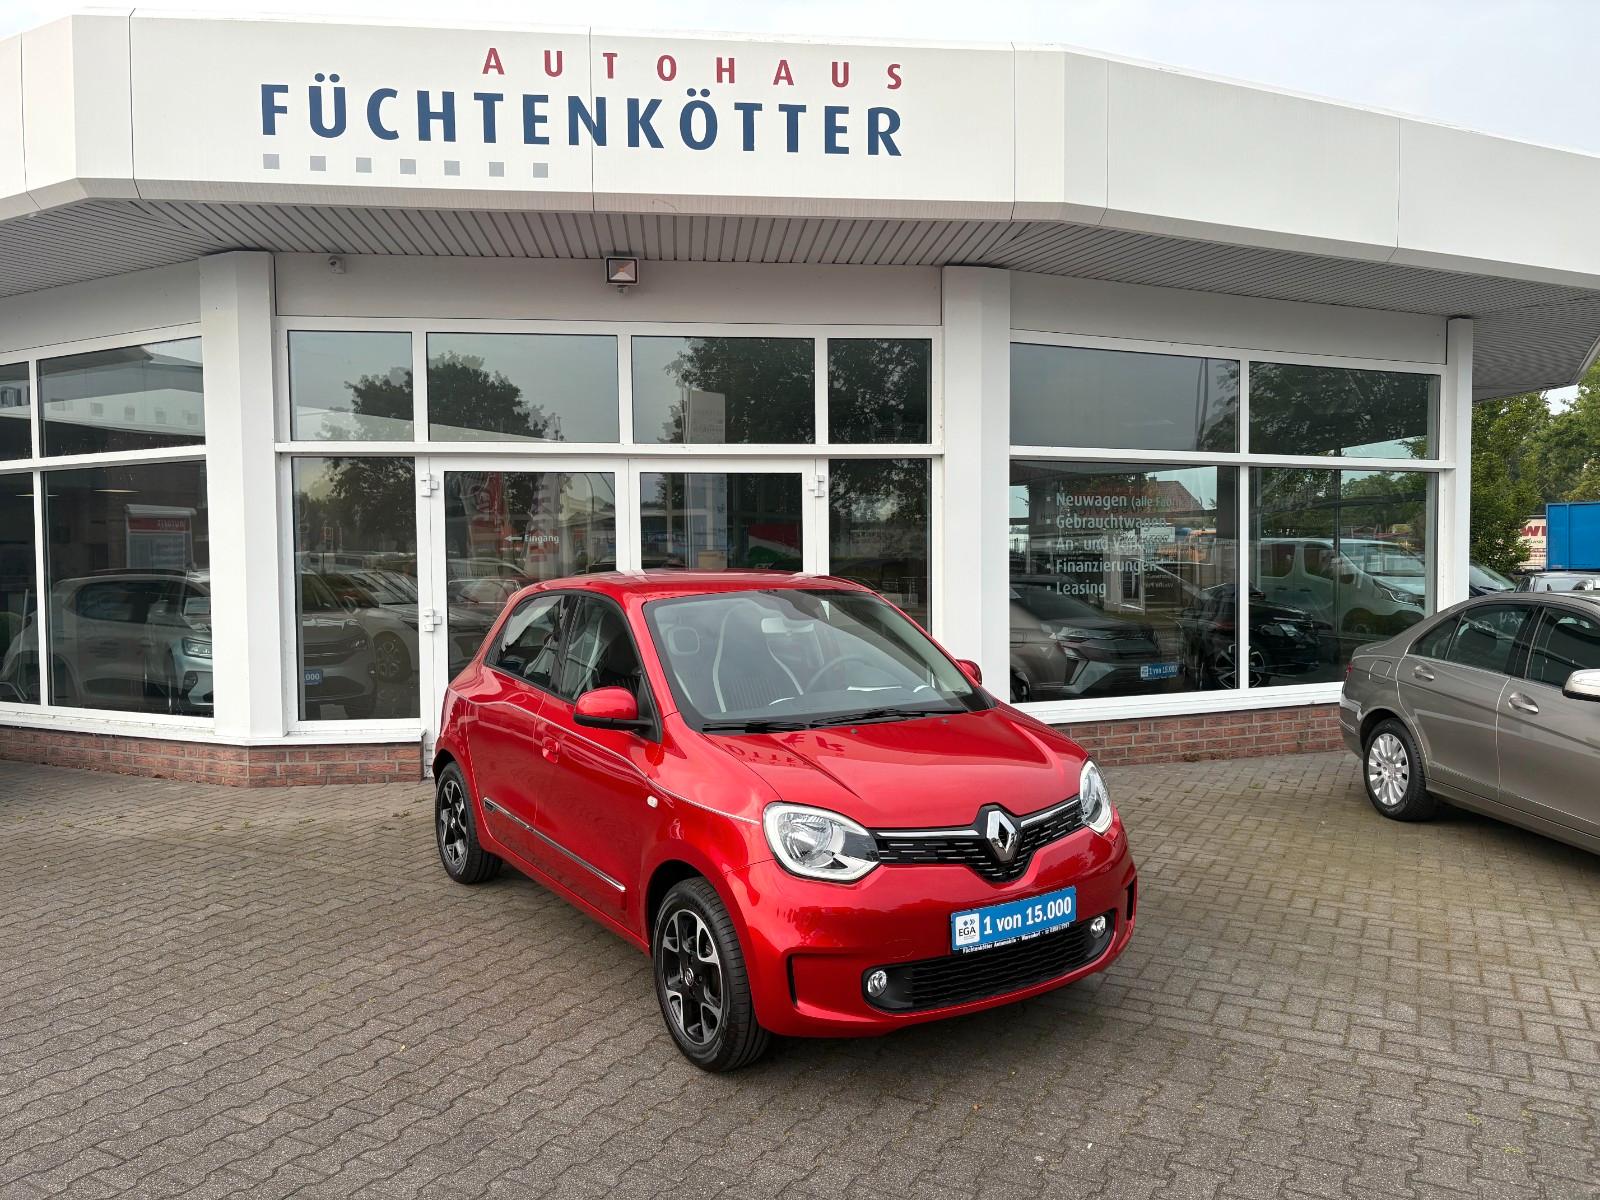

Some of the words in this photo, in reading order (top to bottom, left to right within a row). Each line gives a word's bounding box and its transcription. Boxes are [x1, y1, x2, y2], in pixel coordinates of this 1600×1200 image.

[482, 47, 903, 90] AUTOHAUS
[260, 72, 902, 157] FÜCHTENKÖTTER
[1056, 492, 1127, 510] Neuwagen
[1131, 496, 1153, 510] (alle
[1056, 513, 1167, 533] Gebrauchtwagen
[524, 534, 560, 544] Eingang
[1056, 537, 1079, 551] An-
[1083, 535, 1109, 551] und
[1056, 558, 1158, 575] Finanzierungen
[1056, 580, 1107, 597] Leasing
[983, 915, 993, 935] 1
[996, 912, 1022, 932] von
[1026, 896, 1072, 926] 15.000
[958, 926, 976, 937] EGA
